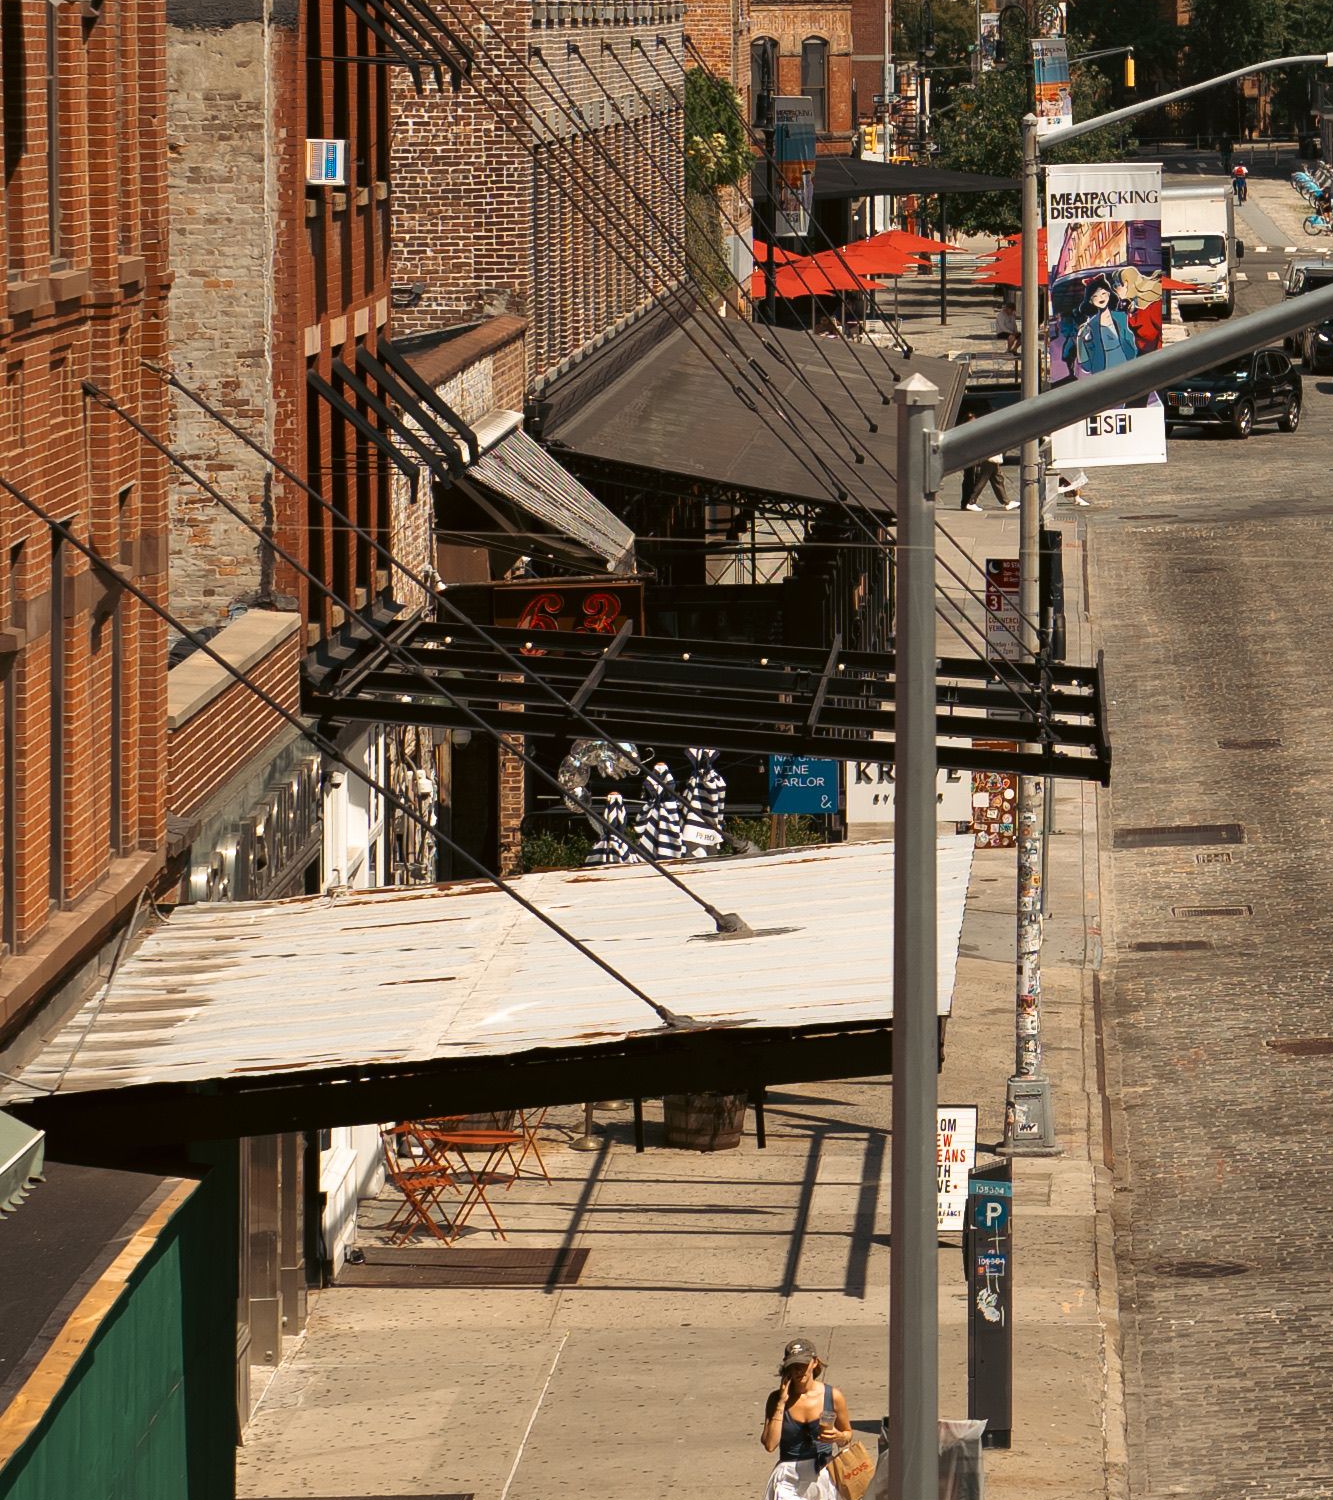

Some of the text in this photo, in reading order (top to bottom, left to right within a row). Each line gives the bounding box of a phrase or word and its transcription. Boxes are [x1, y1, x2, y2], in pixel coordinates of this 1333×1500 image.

[1050, 189, 1159, 207] MEATPACKING
[1050, 204, 1117, 220] DISTRICT
[1086, 414, 1132, 437] HSFI
[989, 595, 998, 610] 3
[773, 764, 809, 775] WINE
[774, 777, 825, 787] PARLOR
[820, 794, 832, 809] &
[940, 1118, 957, 1132] OM
[937, 1134, 953, 1148] EW
[937, 1149, 966, 1163] EANS
[986, 1202, 1003, 1227] P
